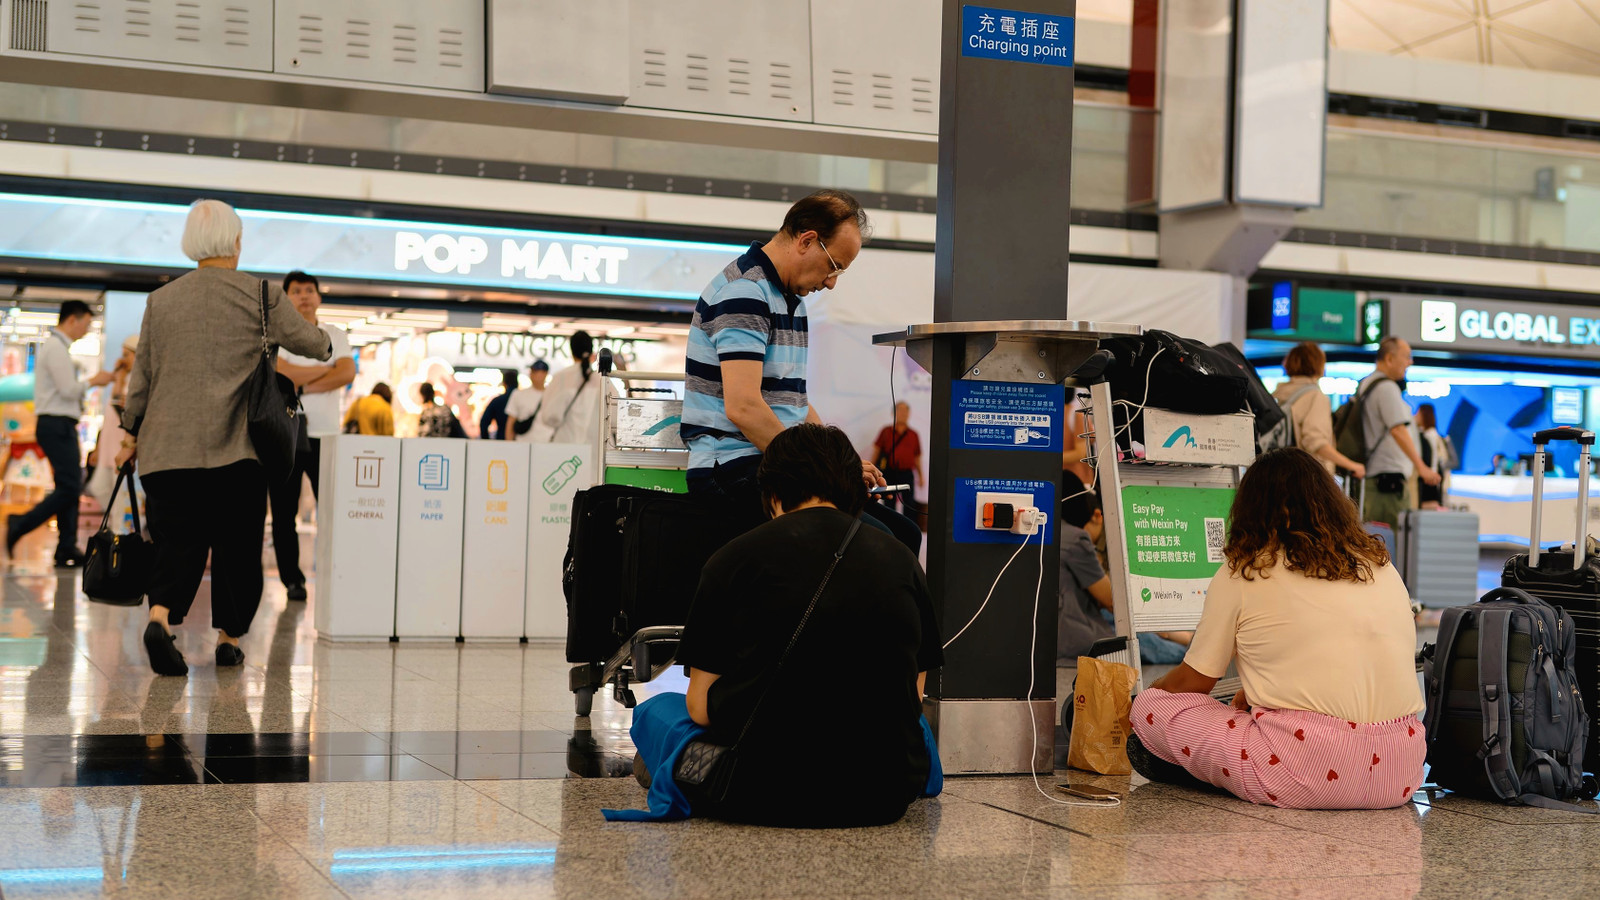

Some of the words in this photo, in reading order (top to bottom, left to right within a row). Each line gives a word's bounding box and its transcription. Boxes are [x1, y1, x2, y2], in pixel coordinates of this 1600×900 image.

[978, 13, 1059, 40] 充電插座
[969, 34, 1029, 57] Charging
[1033, 43, 1067, 58] point
[394, 231, 489, 275] POP
[501, 238, 629, 284] MART
[1459, 309, 1566, 344] GLOBAL
[460, 333, 636, 363] HONGKNG
[347, 510, 384, 520] GENERAL
[420, 512, 443, 520] PAPER
[1132, 503, 1150, 516] Easy
[1150, 503, 1165, 517] Pay
[484, 515, 508, 525] CANS
[1134, 518, 1150, 529] with
[1150, 518, 1174, 530] Weixin
[1174, 519, 1188, 532] Pay
[1153, 590, 1173, 600] Weixin
[1173, 590, 1183, 601] Pay
